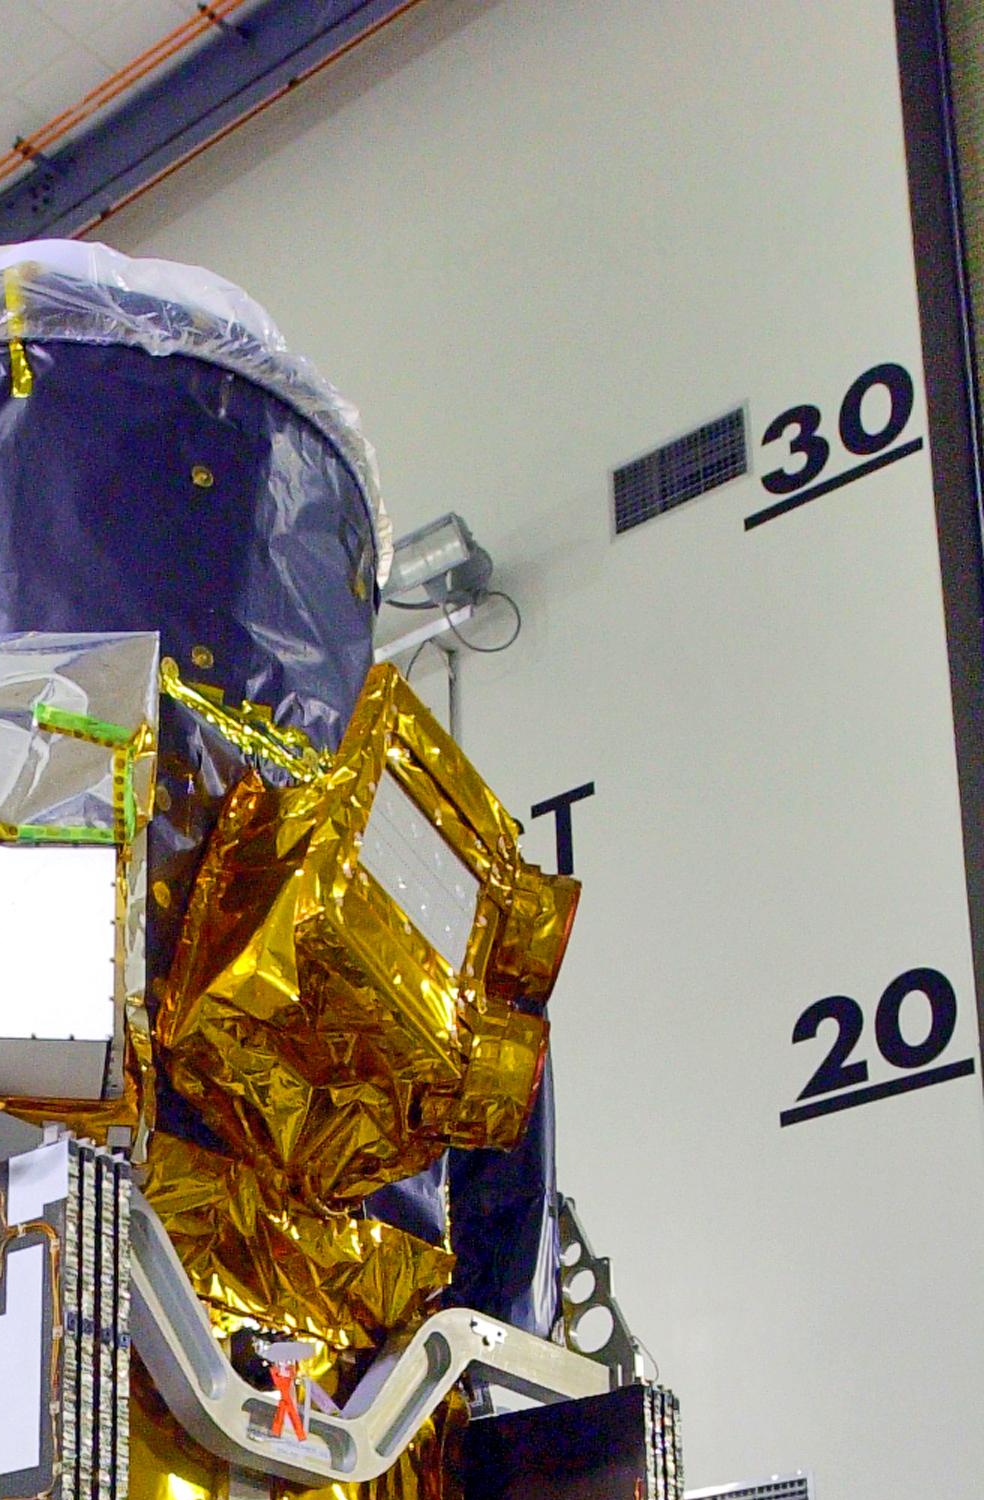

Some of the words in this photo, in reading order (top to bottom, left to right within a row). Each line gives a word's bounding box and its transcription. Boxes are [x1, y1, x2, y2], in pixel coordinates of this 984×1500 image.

[760, 361, 915, 495] 30
[513, 781, 595, 876] T
[792, 966, 958, 1103] 20
